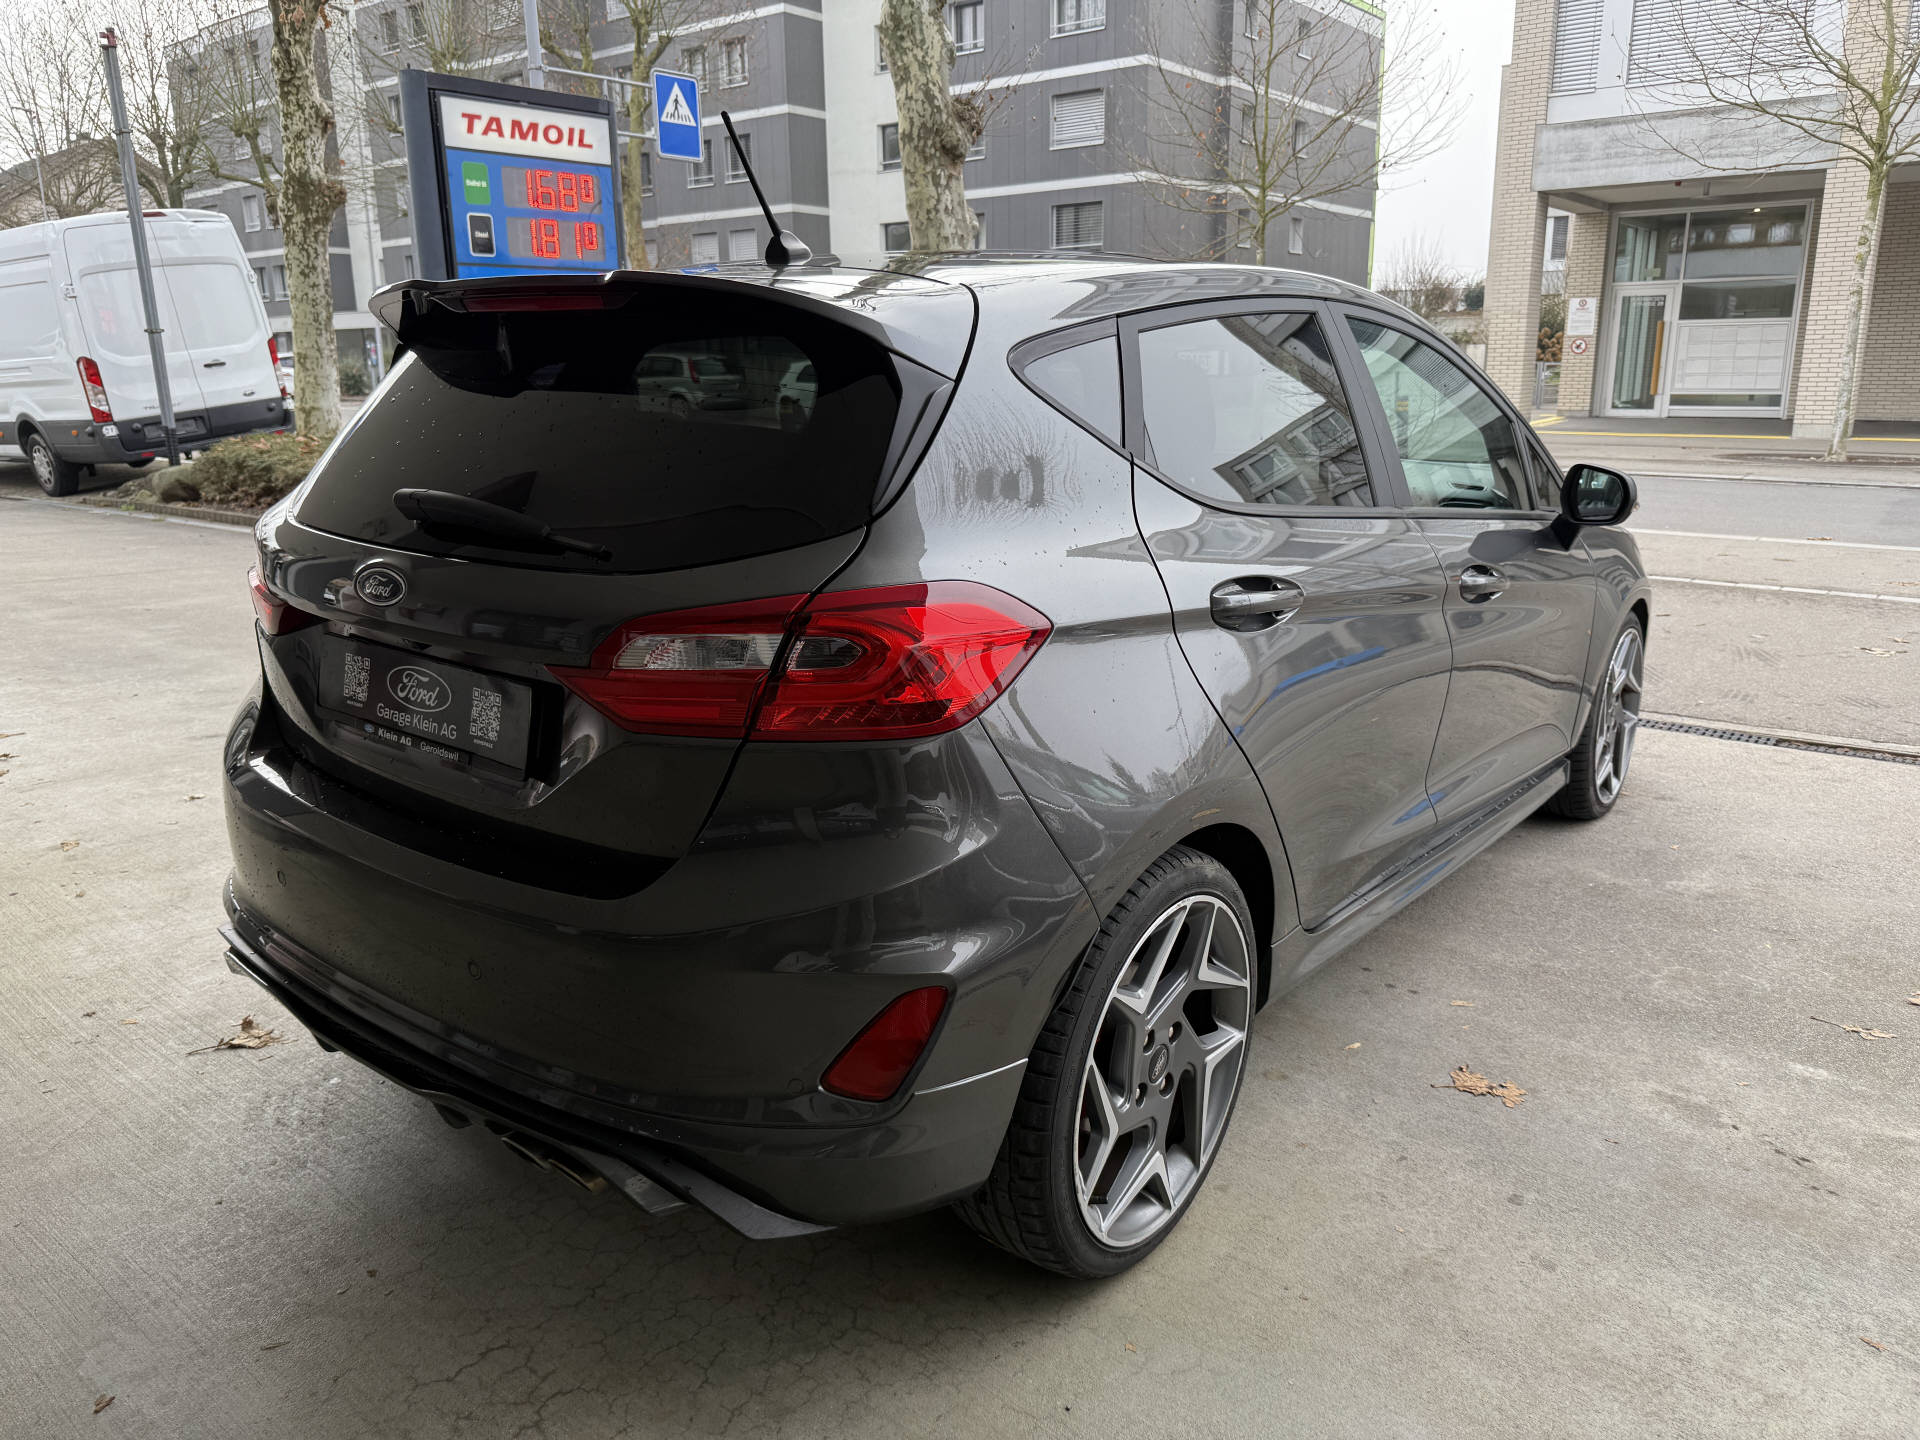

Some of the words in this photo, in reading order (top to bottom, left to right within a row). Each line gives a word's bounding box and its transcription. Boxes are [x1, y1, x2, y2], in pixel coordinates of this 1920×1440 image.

[461, 112, 593, 149] TAMOIL
[366, 575, 393, 597] Ford
[397, 670, 440, 706] Ford
[376, 703, 411, 727] Garage
[413, 713, 438, 734] Klein
[440, 722, 457, 740] AG
[378, 727, 398, 742] Klein
[400, 735, 412, 746] AG
[420, 742, 459, 761] Geroldswil
